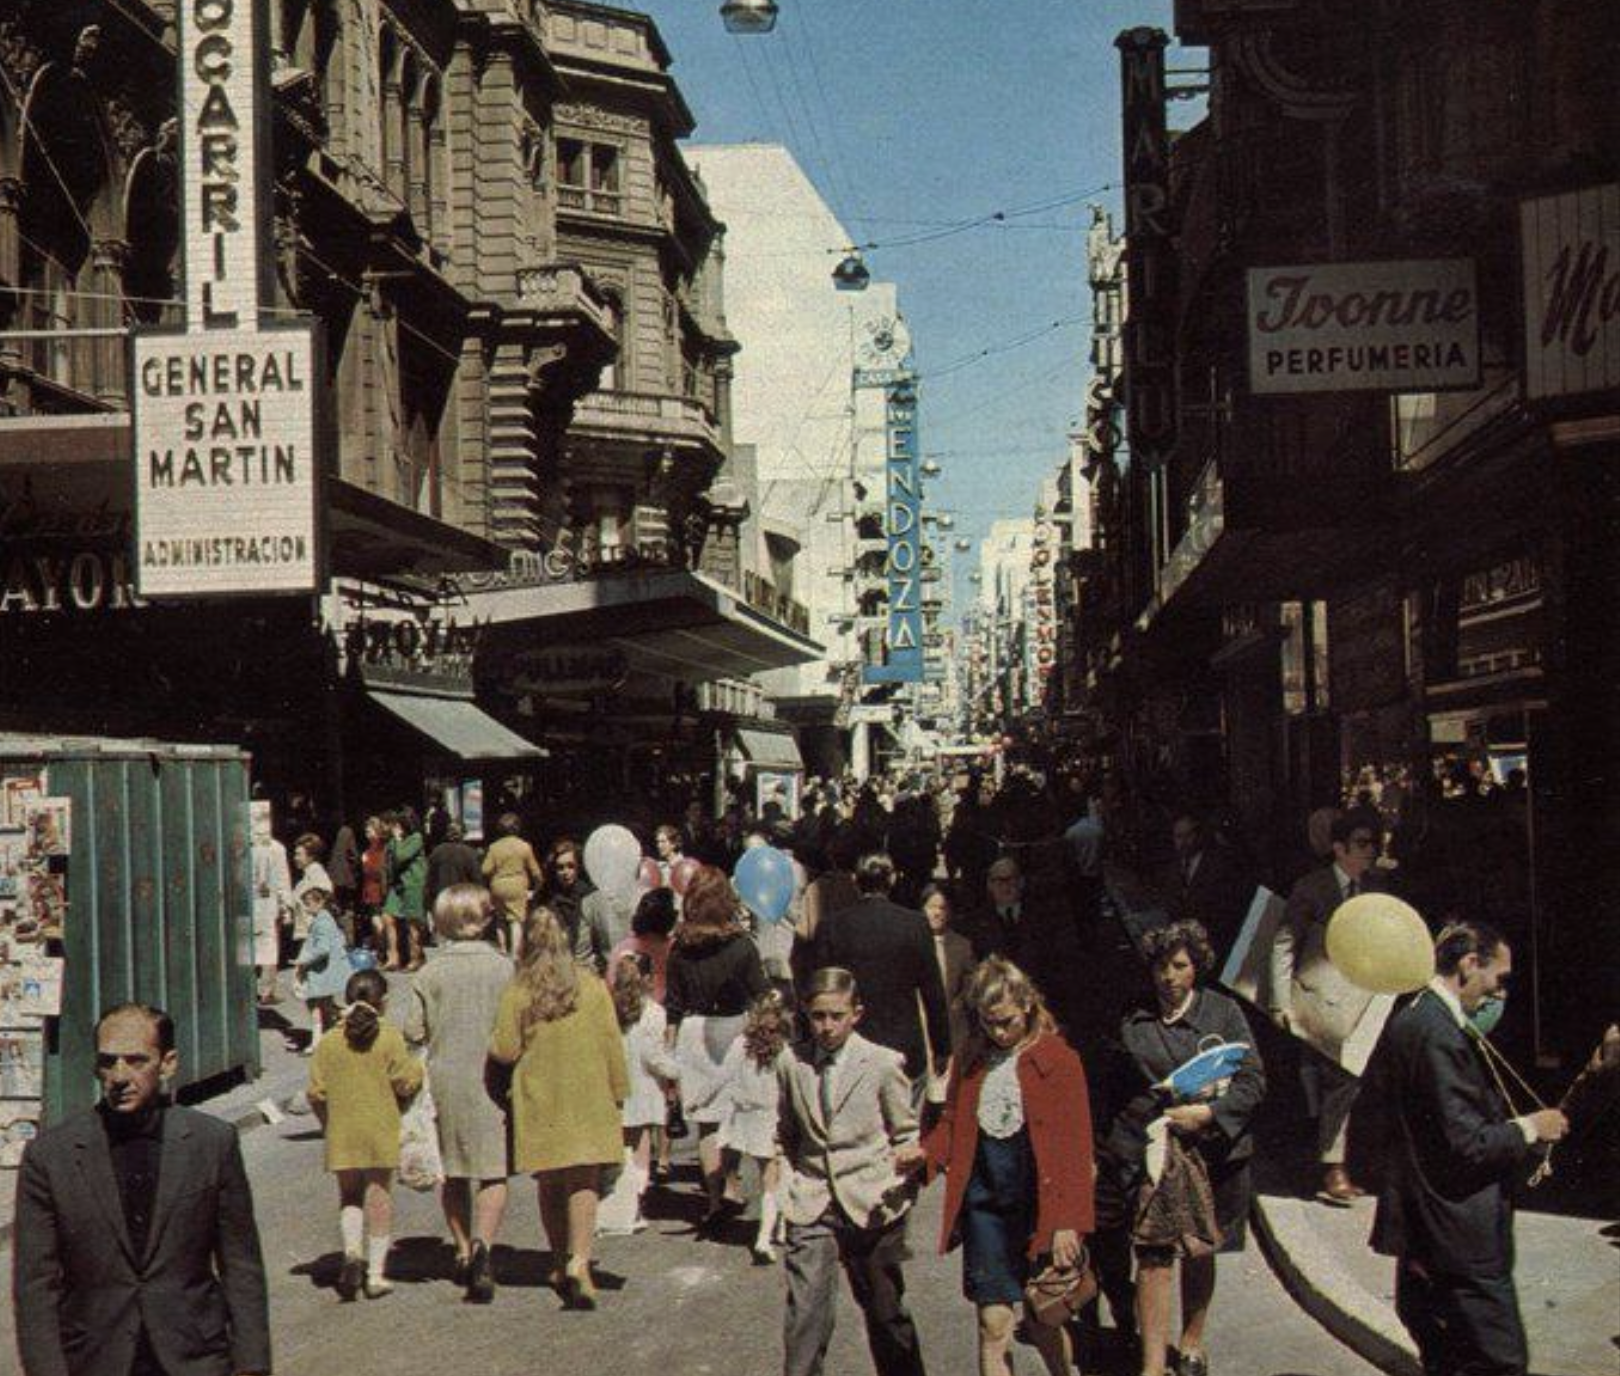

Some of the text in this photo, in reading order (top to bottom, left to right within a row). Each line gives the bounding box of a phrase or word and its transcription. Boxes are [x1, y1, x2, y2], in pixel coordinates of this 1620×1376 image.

[142, 352, 304, 397] GENERAL
[1267, 342, 1468, 375] PERFUMERIA
[185, 400, 261, 440] SAN
[150, 445, 296, 488] MARTIN
[144, 535, 307, 567] ADMINISTRACION
